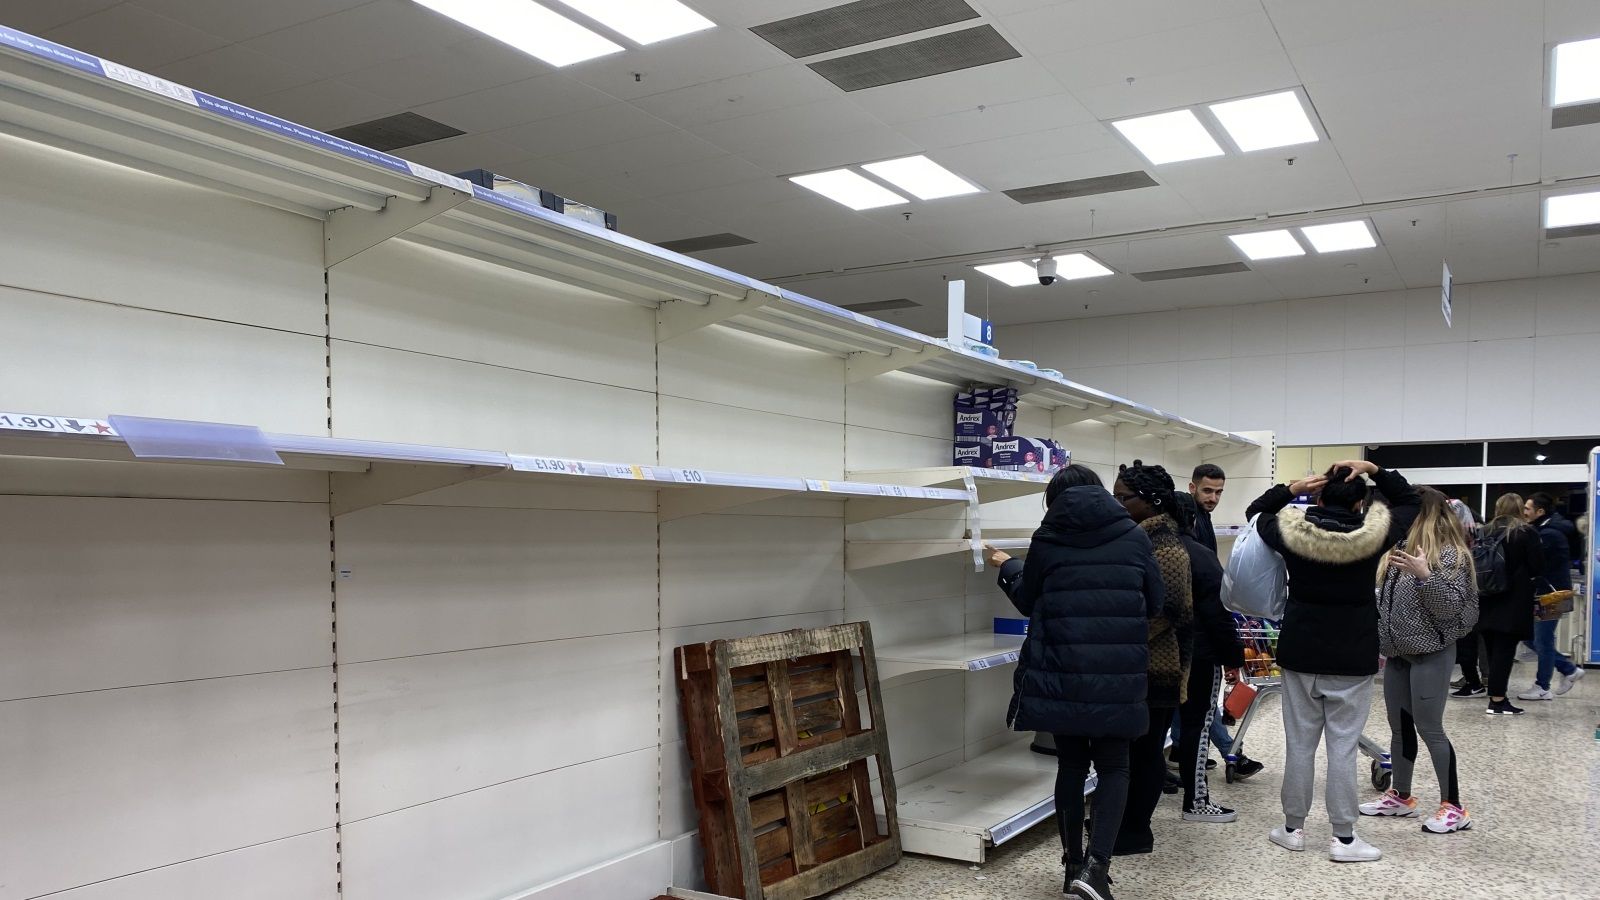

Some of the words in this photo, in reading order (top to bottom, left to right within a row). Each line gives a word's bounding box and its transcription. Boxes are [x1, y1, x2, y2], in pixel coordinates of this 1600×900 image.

[200, 97, 214, 106] This
[214, 102, 229, 111] shelf
[986, 325, 992, 341] 8
[0, 415, 55, 429] 1.90
[957, 448, 978, 457] Andrex
[995, 442, 1016, 451] Andrex
[534, 458, 565, 471] £1.90
[683, 469, 702, 482] £10
